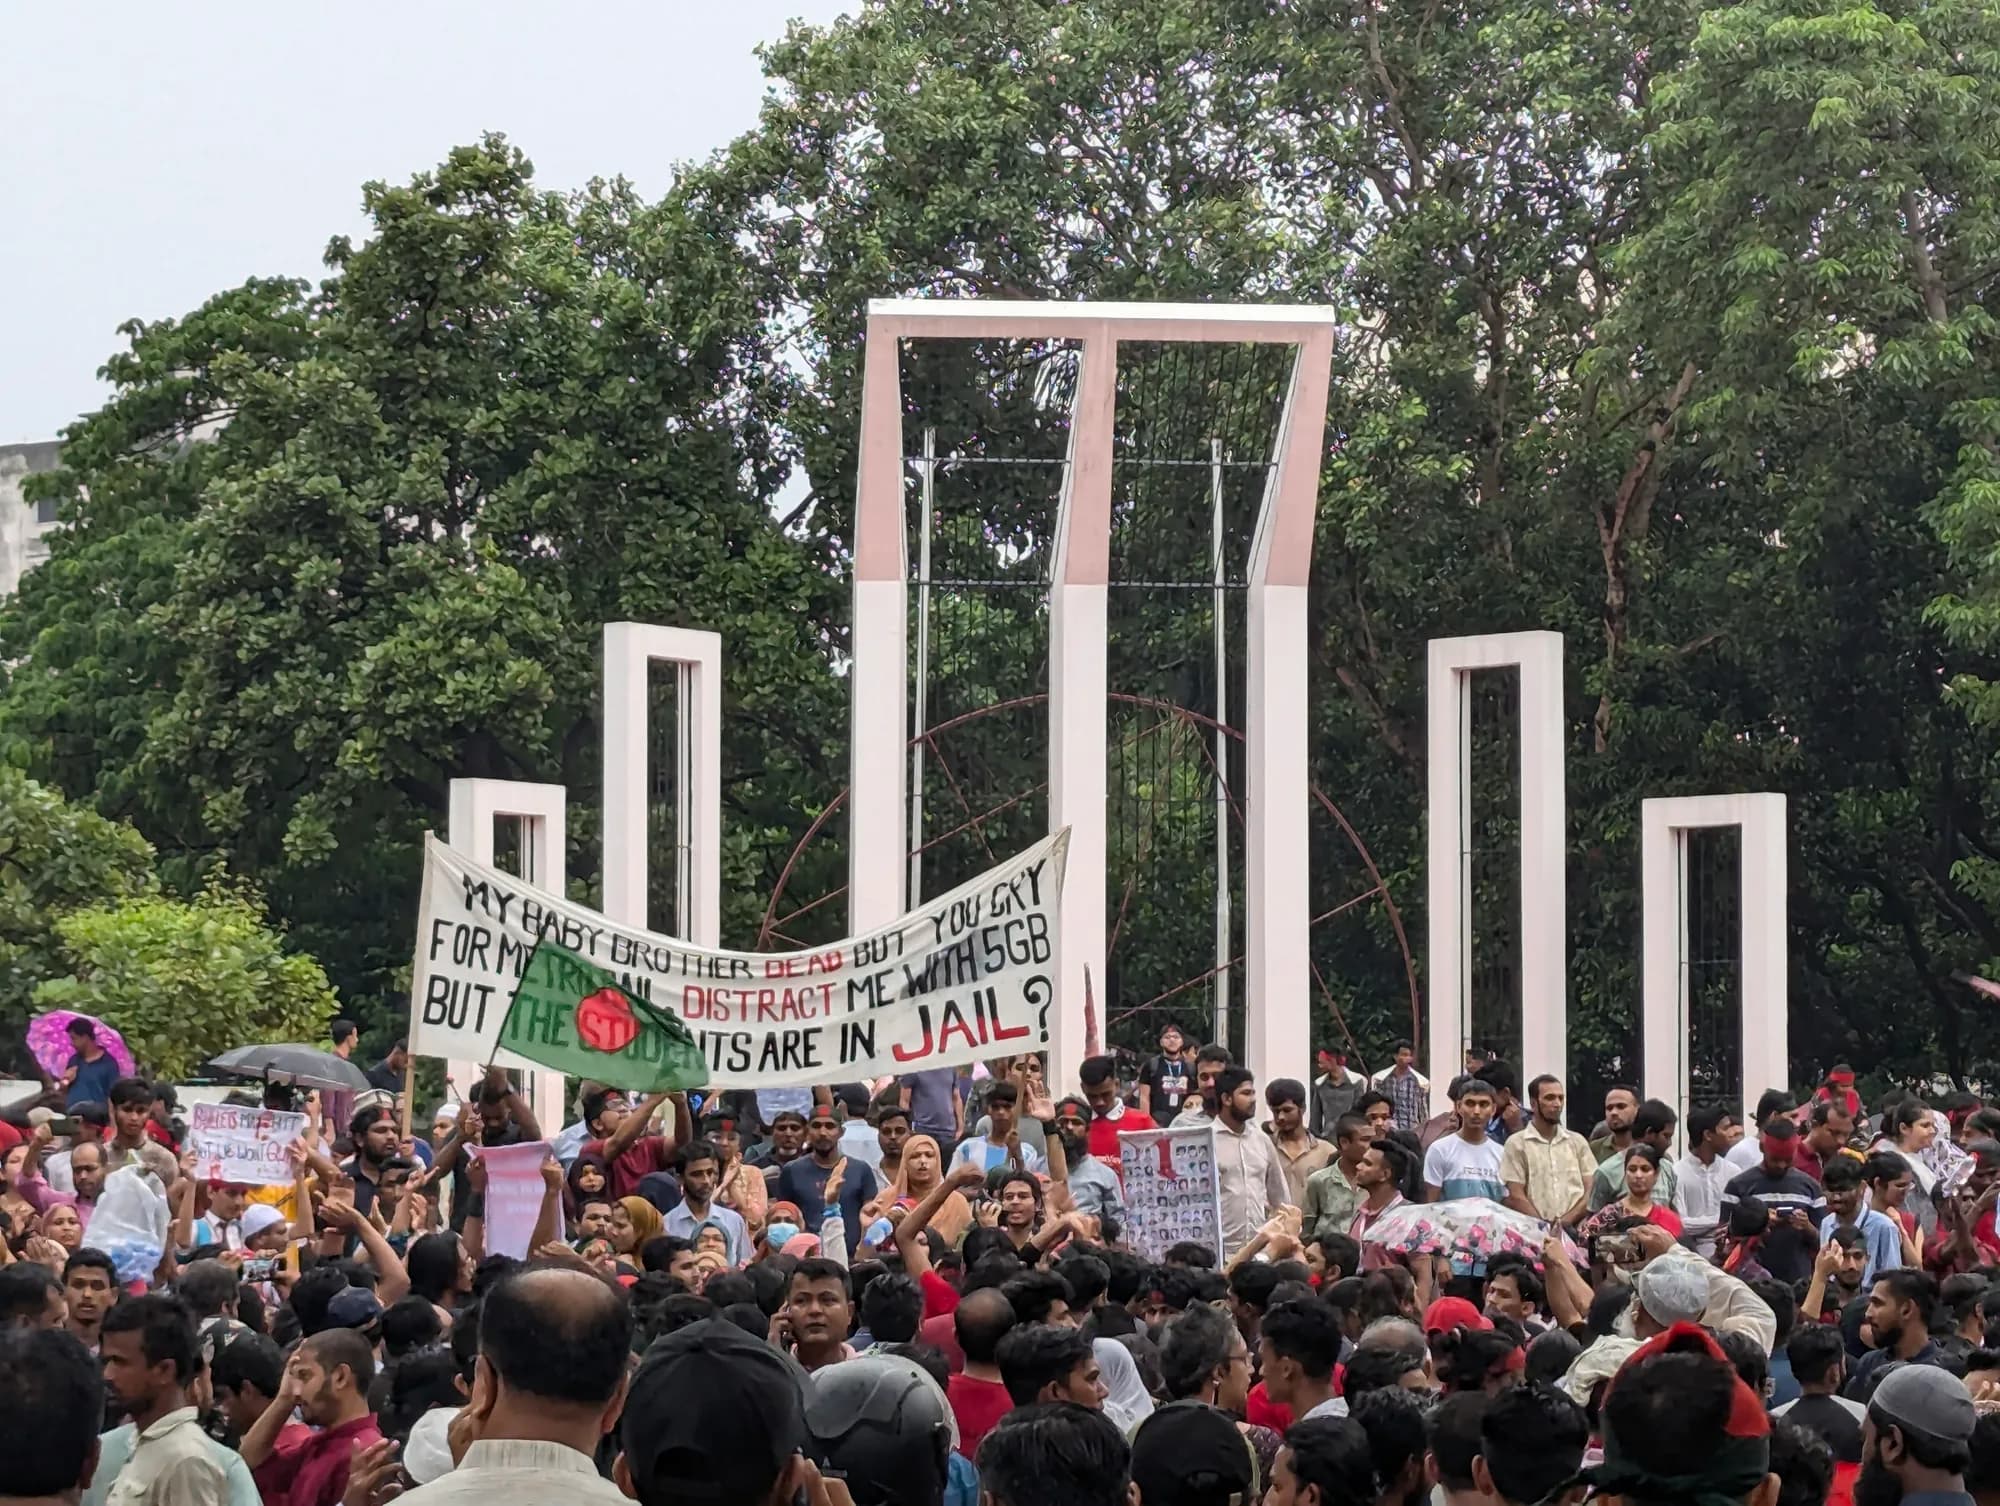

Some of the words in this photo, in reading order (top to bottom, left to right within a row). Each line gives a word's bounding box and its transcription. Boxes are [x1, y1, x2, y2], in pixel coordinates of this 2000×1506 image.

[430, 918, 491, 971] FOR
[683, 983, 837, 1023] DISTRACT
[847, 969, 895, 1012] ME
[903, 941, 978, 998] WITH
[982, 912, 1051, 973] 5GB
[463, 872, 516, 924] MY
[522, 898, 604, 956] BABY
[611, 932, 753, 979] BROTHER
[764, 951, 843, 980] DEAD
[853, 925, 913, 968] BUT
[930, 894, 981, 945] YOU
[990, 858, 1046, 918] CRY
[423, 974, 496, 1033] BUT
[508, 991, 574, 1046] THE
[758, 1027, 822, 1072] ARE
[839, 1019, 875, 1064] IN
